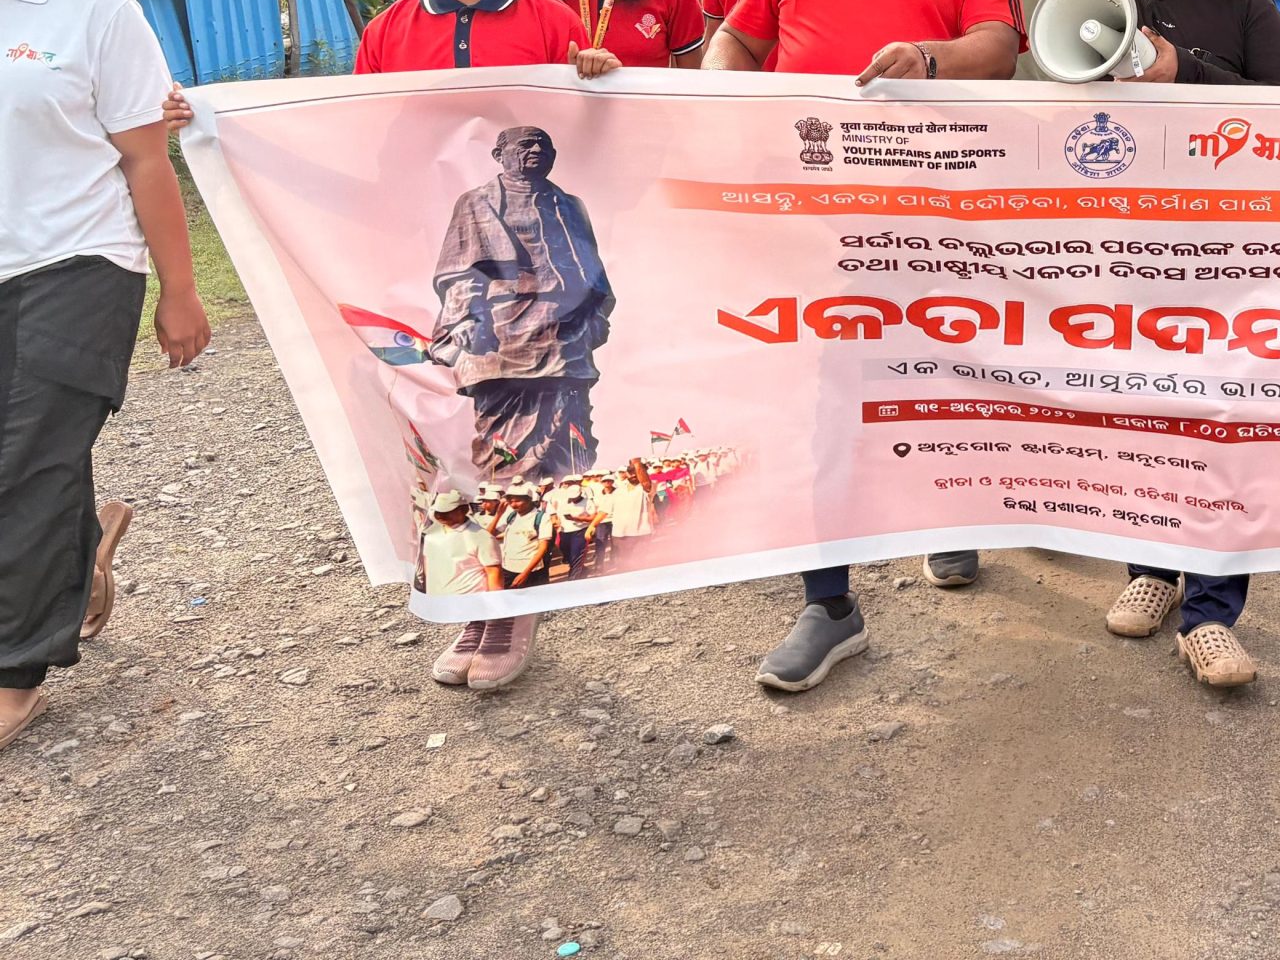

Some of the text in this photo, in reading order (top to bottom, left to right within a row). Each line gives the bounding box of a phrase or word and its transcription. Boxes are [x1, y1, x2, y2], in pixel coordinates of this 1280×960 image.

[840, 122, 988, 133] युवा कार्यक्रम एवं खेल मंत्रालय
[842, 134, 910, 145] MINISTRY OF
[843, 146, 1006, 159] YOUTH AFFAIRS AND SPORTS
[843, 156, 977, 170] GOVERNMENT OF INDIA
[811, 192, 887, 206] ଏକତା
[897, 194, 952, 209] ପାଇଁ
[1137, 194, 1209, 211] ନିର୍ମାଣ
[1219, 196, 1272, 212] ପାଇଁ
[837, 259, 898, 272] ତଥା
[1012, 264, 1101, 280] ଏକତା
[1109, 261, 1186, 281] ଦିବସ
[716, 293, 1025, 345] ଏକତା
[887, 361, 939, 375] ଏକ
[952, 364, 1051, 388] ଭାରତ,
[1112, 416, 1170, 430] ସକାଳ
[917, 441, 1012, 456] ଅନୁଗୋଳ
[1117, 450, 1208, 472] ଅନୁଗୋଳ
[979, 476, 992, 486] ଓ
